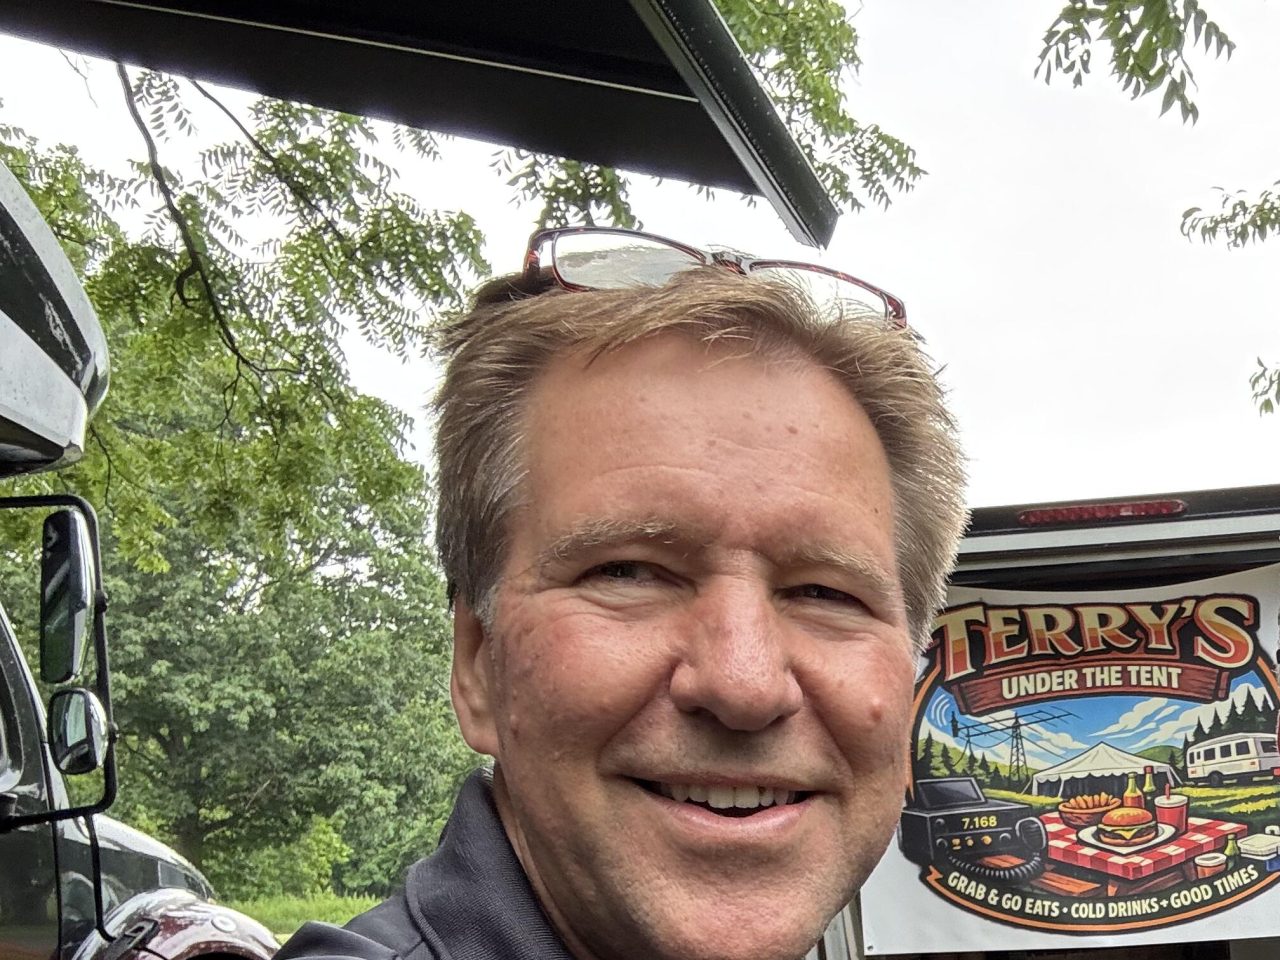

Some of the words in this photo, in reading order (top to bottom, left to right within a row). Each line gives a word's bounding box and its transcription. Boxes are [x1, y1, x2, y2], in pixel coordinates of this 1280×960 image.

[931, 596, 1256, 682] TERRY'S
[1002, 667, 1077, 699] UNDER
[1082, 665, 1123, 690] THE
[1127, 665, 1182, 690] TENT
[961, 815, 998, 830] 7.168
[947, 871, 985, 901] GRAB
[987, 892, 999, 906] &
[1001, 896, 1021, 912] GO
[1024, 899, 1061, 918] EATS
[1071, 904, 1105, 919] COLD
[1108, 897, 1159, 918] DRINKS
[1170, 884, 1213, 909] GOOD
[1217, 864, 1259, 897] TIMES
